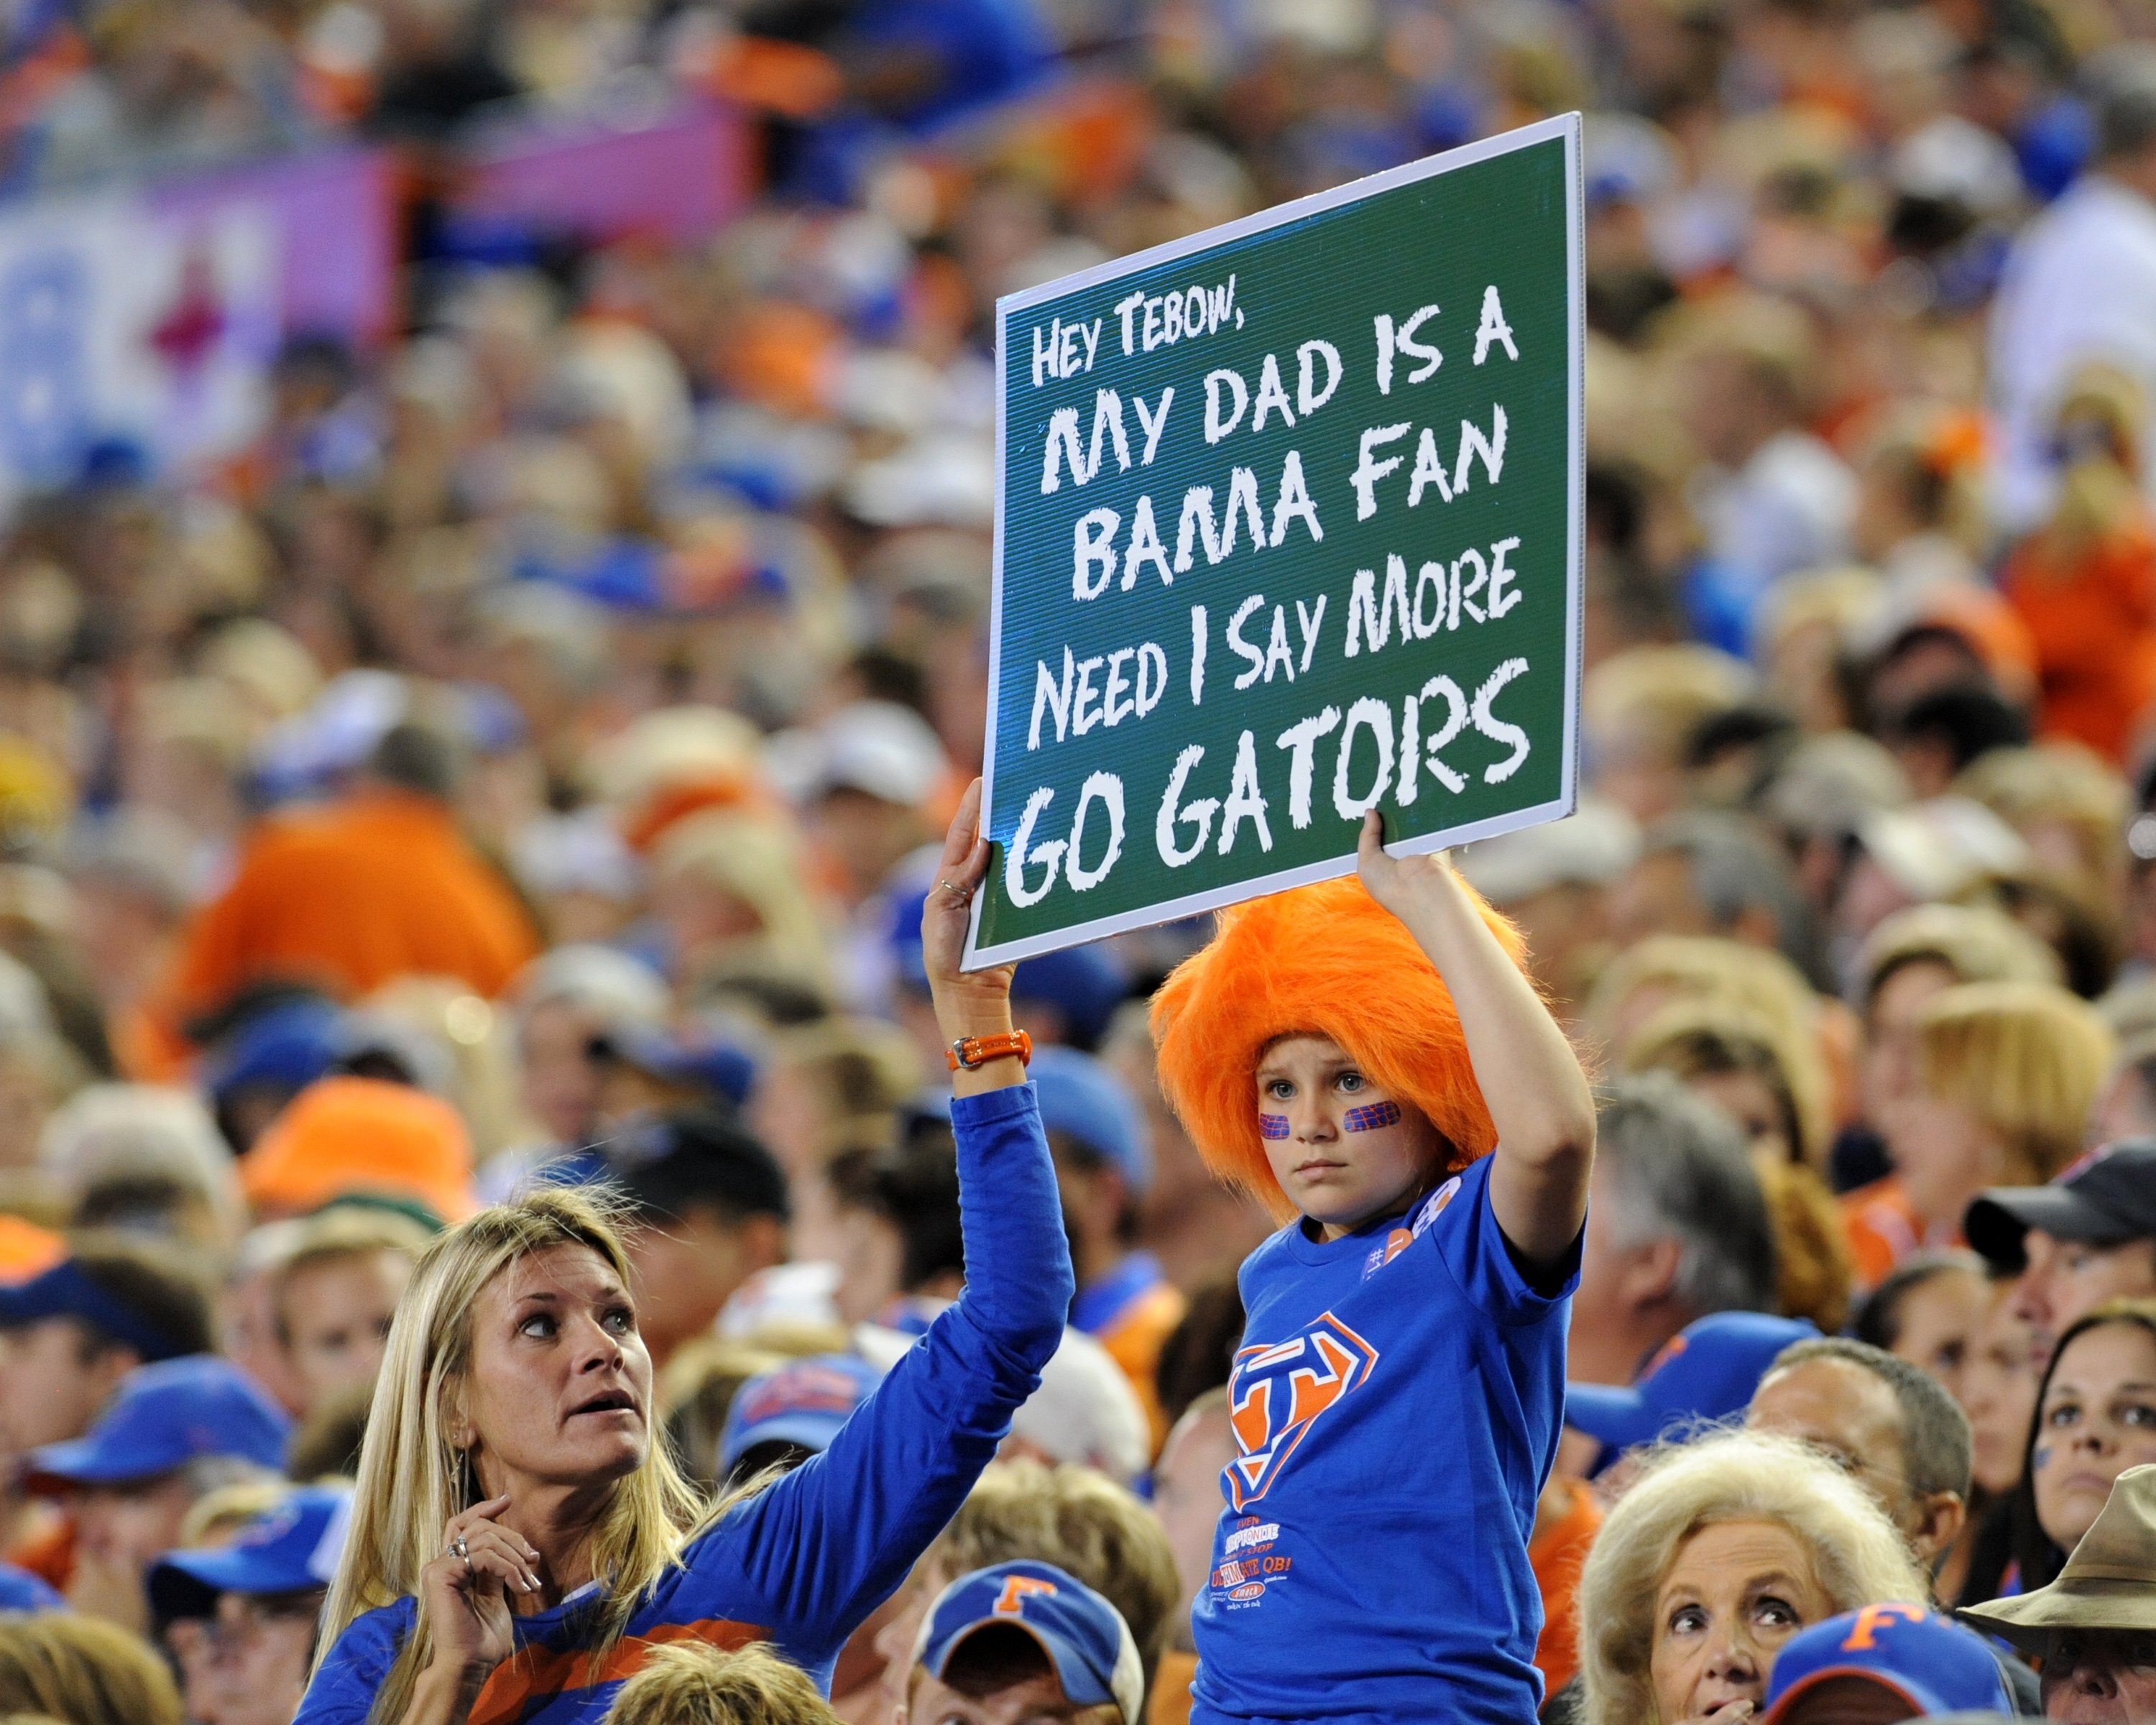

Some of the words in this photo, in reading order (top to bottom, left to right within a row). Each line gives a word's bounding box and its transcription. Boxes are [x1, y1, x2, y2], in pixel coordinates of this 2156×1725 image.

[1032, 318, 1102, 387] HEY
[1114, 274, 1245, 356] TEBOW,
[1041, 388, 1174, 494] MY
[1204, 340, 1343, 445] DAD
[1374, 305, 1443, 395] IS
[1473, 285, 1519, 365] A
[1073, 451, 1323, 601] BAMA
[1350, 402, 1508, 522] FAN
[1027, 642, 1168, 751] NEED
[1191, 605, 1207, 705] I
[1226, 594, 1327, 690] SAY
[1345, 537, 1521, 657] MORE
[1005, 770, 1125, 908] GO
[1156, 657, 1530, 868] GATORS
[1212, 1558, 1261, 1588] ULTIMATE
[1263, 1555, 1292, 1573] QB!
[1237, 1516, 1260, 1530] EVEN
[1247, 1543, 1274, 1555] STOP
[1841, 1604, 1924, 1652] F
